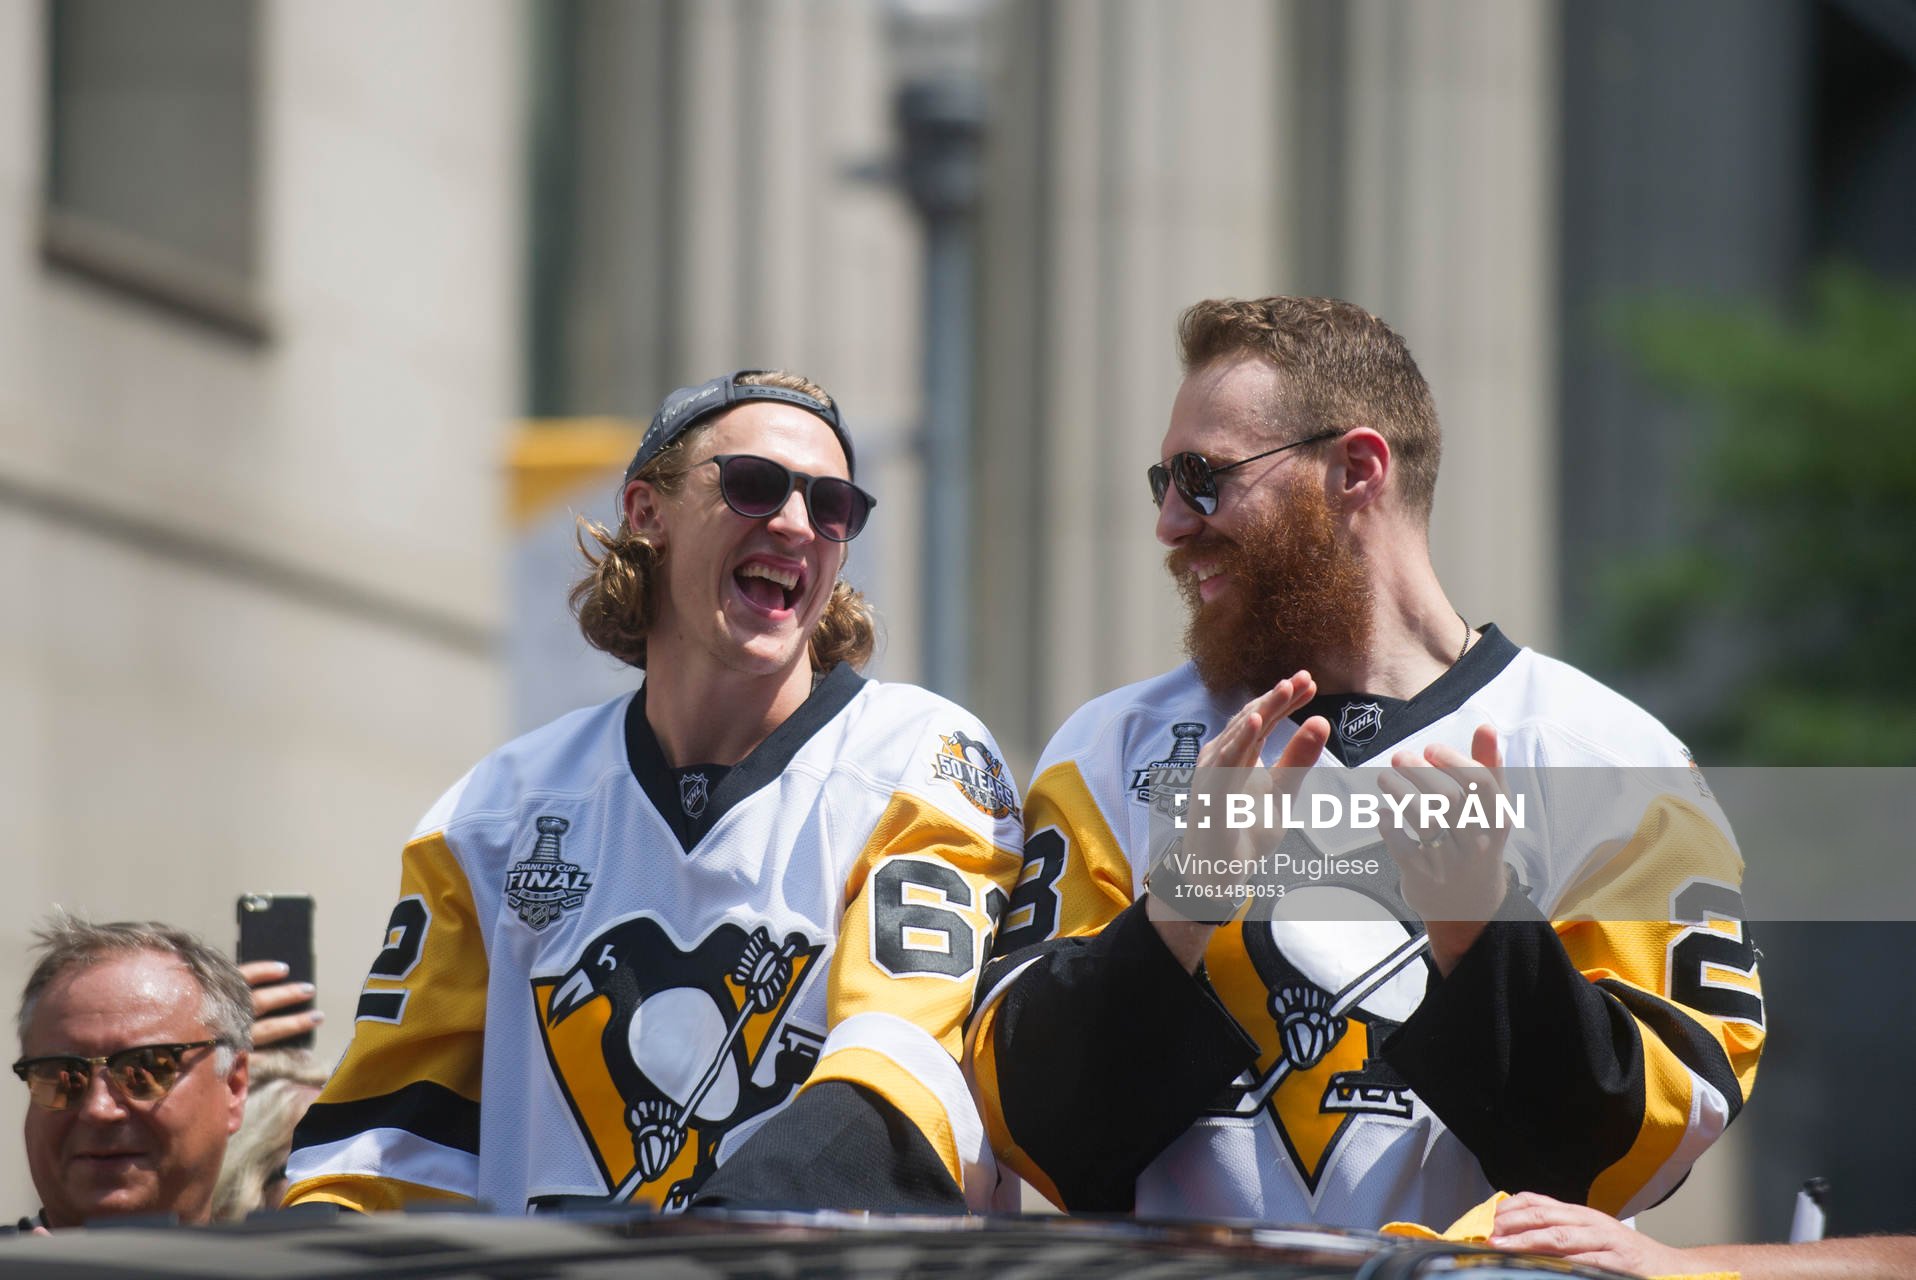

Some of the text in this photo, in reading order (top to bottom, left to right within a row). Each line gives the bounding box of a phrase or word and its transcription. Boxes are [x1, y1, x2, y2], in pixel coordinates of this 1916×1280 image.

[1348, 713, 1374, 736] NHL
[1151, 761, 1197, 769] STANLEY
[939, 756, 1014, 808] 50 YEARS
[1135, 769, 1195, 787] FIN
[516, 863, 579, 873] STANLEY CUP
[508, 871, 589, 890] FINAL
